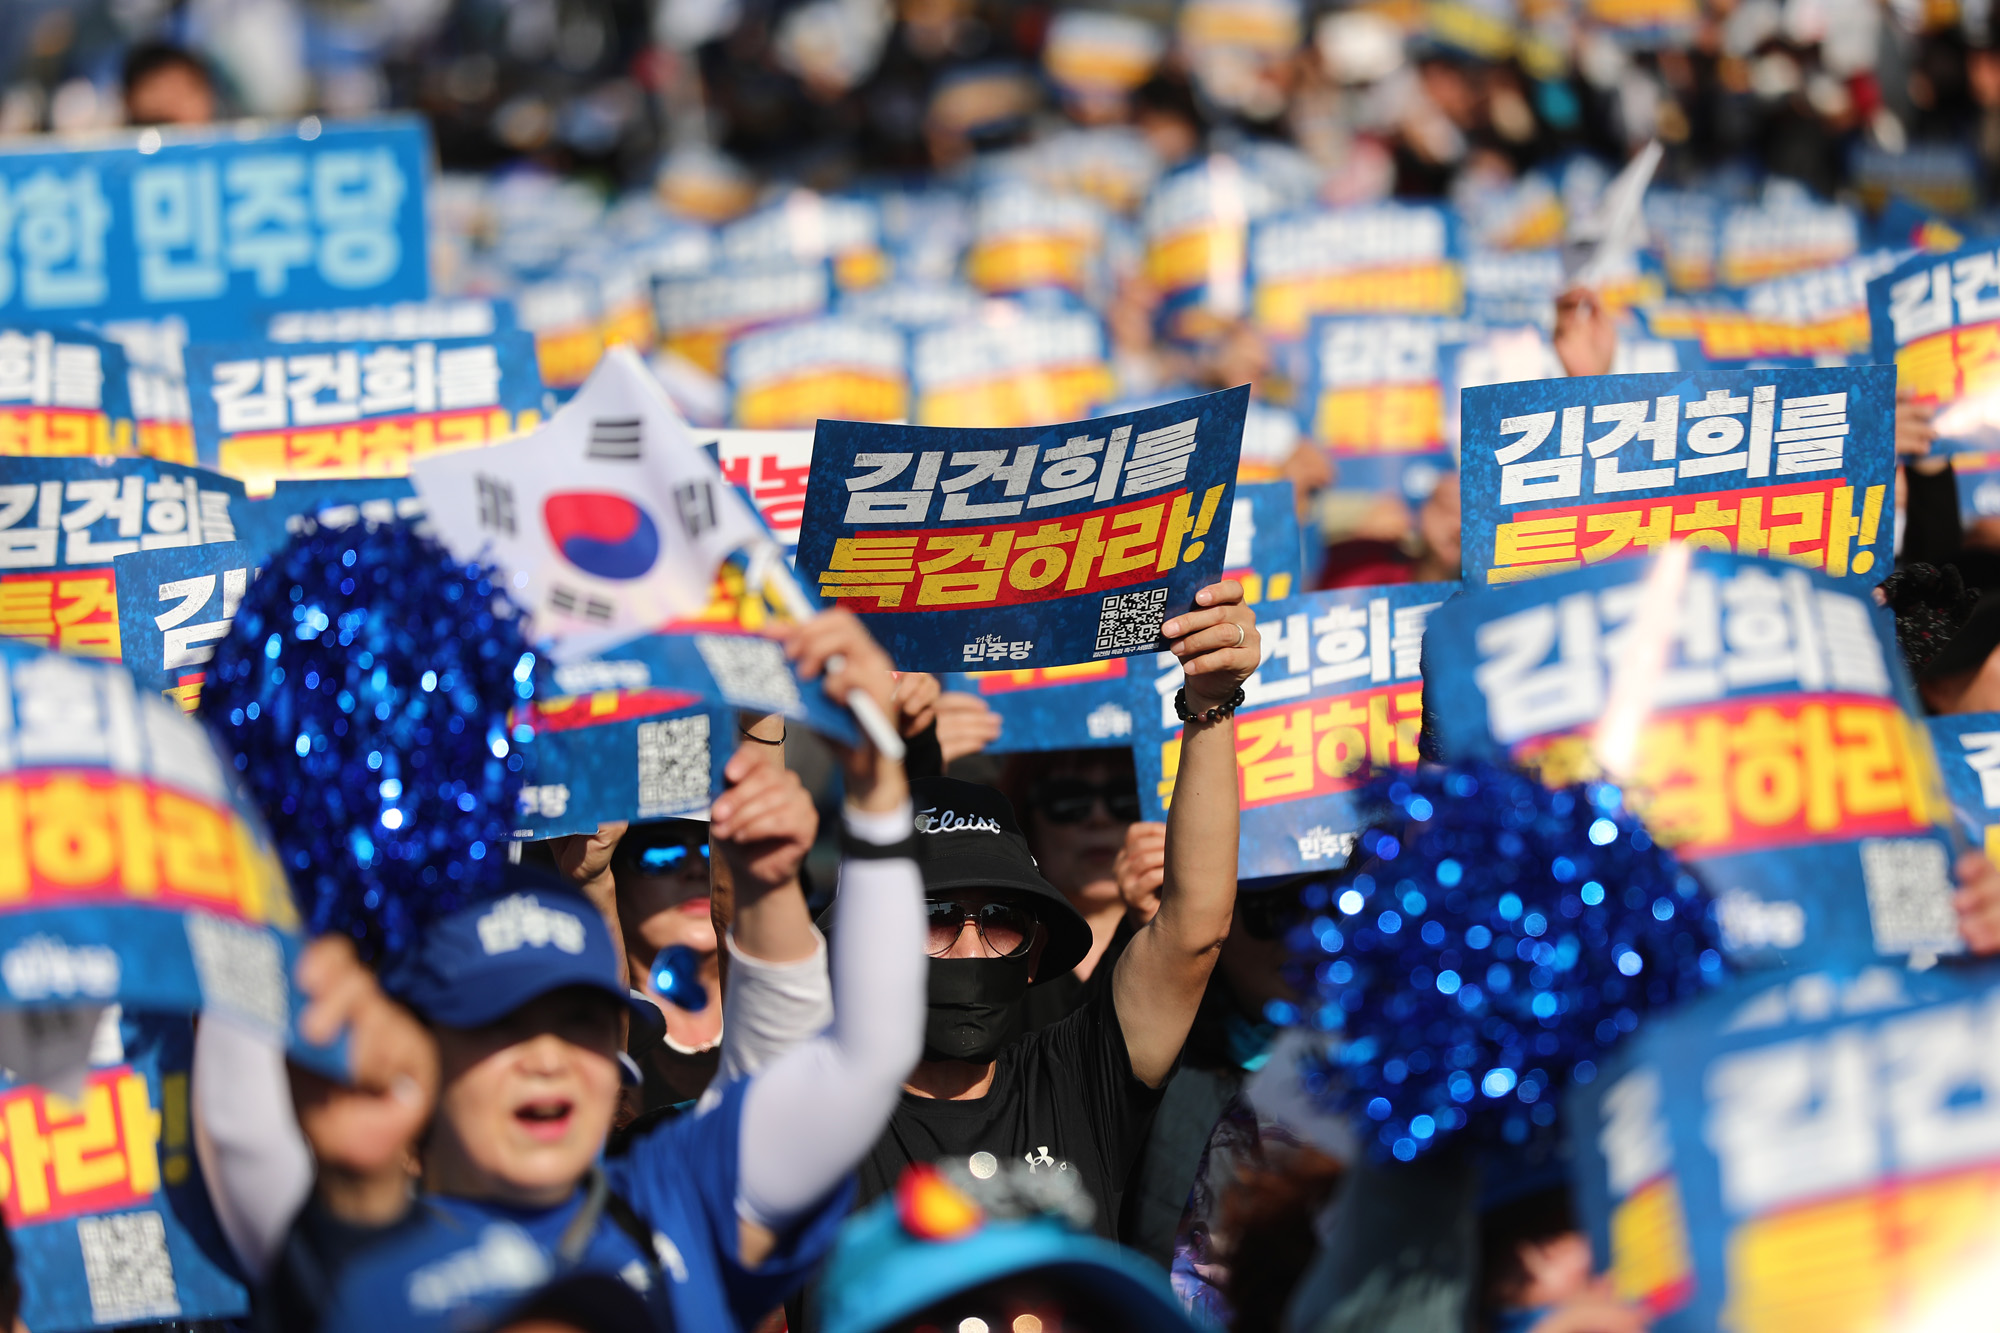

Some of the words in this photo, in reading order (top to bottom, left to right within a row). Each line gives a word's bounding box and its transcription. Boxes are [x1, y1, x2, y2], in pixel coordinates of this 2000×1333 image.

[131, 147, 405, 300] 민주당
[210, 342, 502, 432] 김건희를
[843, 417, 1200, 525] 김건희를
[1494, 385, 1850, 506] 김건희를
[818, 483, 1227, 608] 특검하라!
[962, 641, 1034, 662] 민주당
[974, 633, 1002, 646] 더불어
